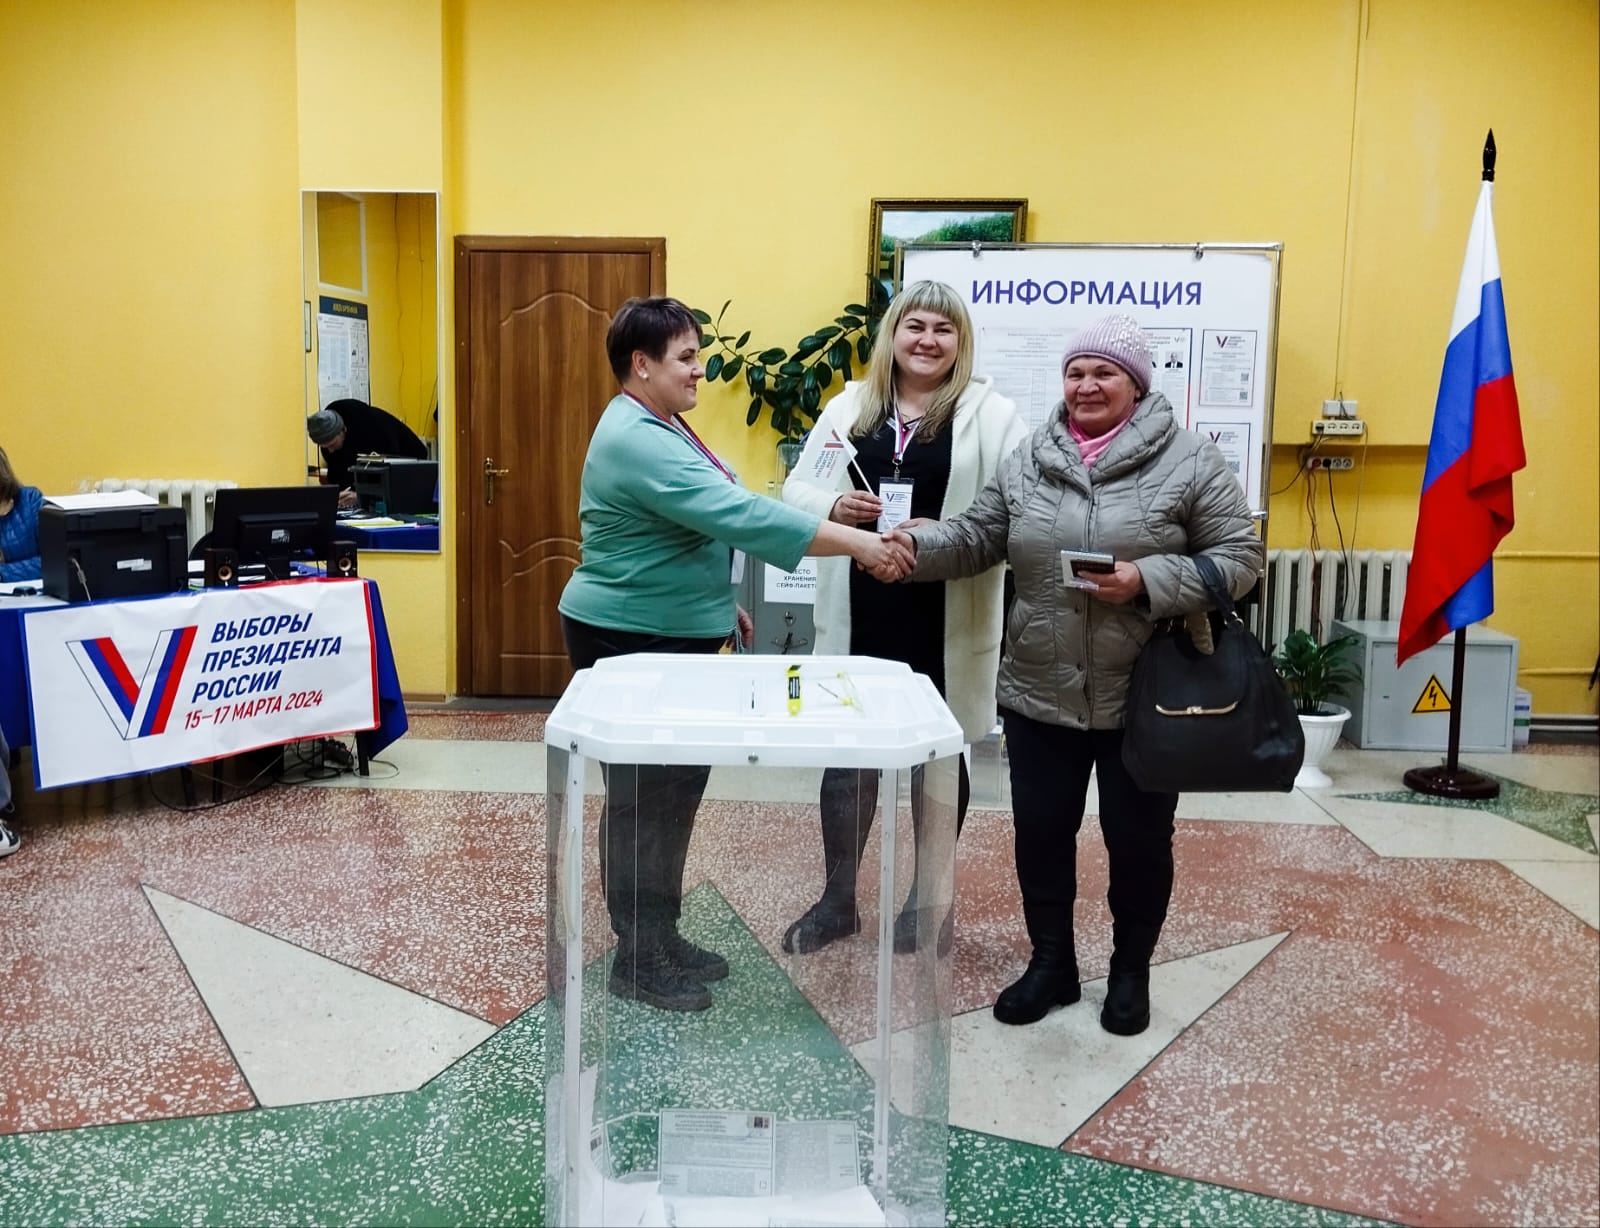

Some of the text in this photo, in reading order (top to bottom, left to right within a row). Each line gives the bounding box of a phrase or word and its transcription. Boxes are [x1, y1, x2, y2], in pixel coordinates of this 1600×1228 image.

[971, 279, 1203, 309] ИНФОРМАЦИЯ
[210, 612, 314, 644] ВЫБОРЫ
[201, 635, 343, 674] ПРЕЗИДЕНТА
[191, 669, 283, 704] РОССИИ
[231, 695, 283, 722] МАРТА
[284, 689, 324, 711] 2024
